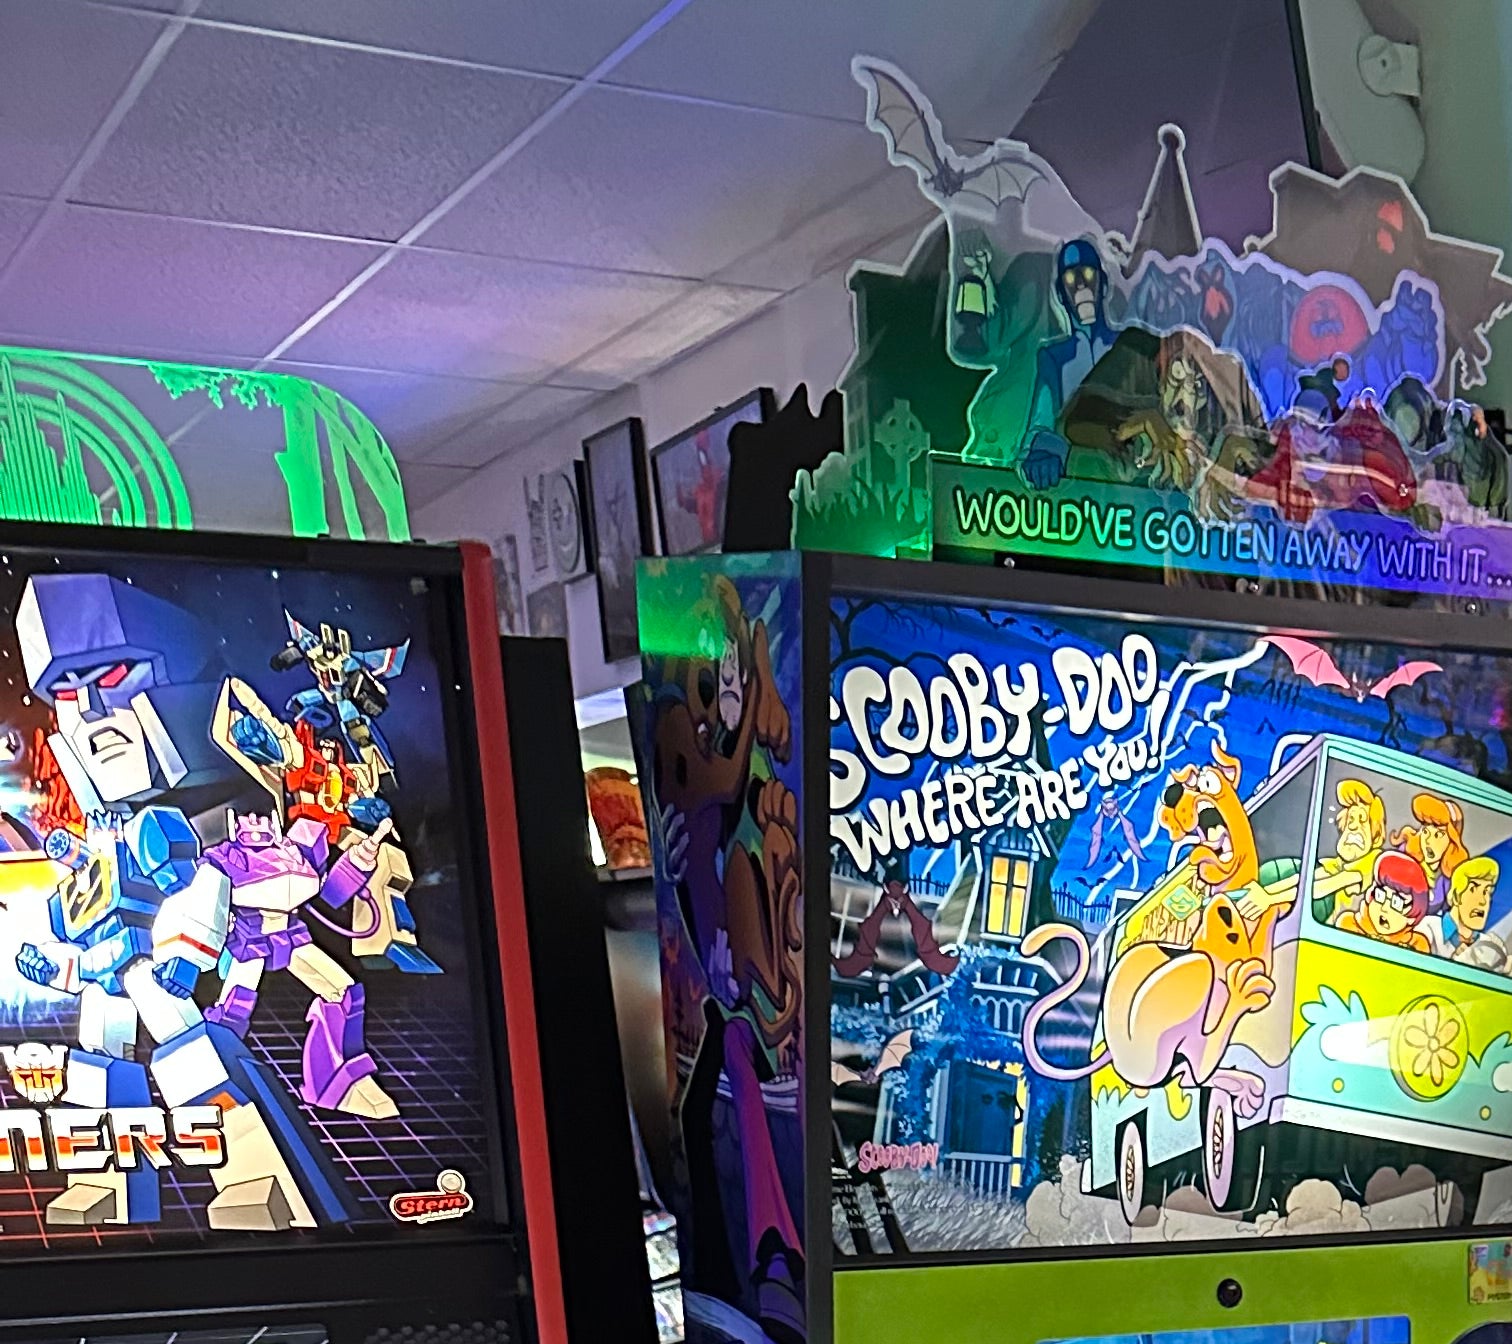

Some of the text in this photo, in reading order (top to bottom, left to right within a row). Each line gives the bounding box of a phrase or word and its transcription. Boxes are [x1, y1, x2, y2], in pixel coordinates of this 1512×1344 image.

[954, 488, 1133, 548] WOULD'VE
[1143, 510, 1276, 562] GOTTEN
[1283, 526, 1372, 570] AWAY
[1376, 537, 1452, 582] WITH
[830, 773, 1001, 873] WHERE
[1014, 761, 1089, 829] ARE
[398, 1192, 468, 1217] Stern
